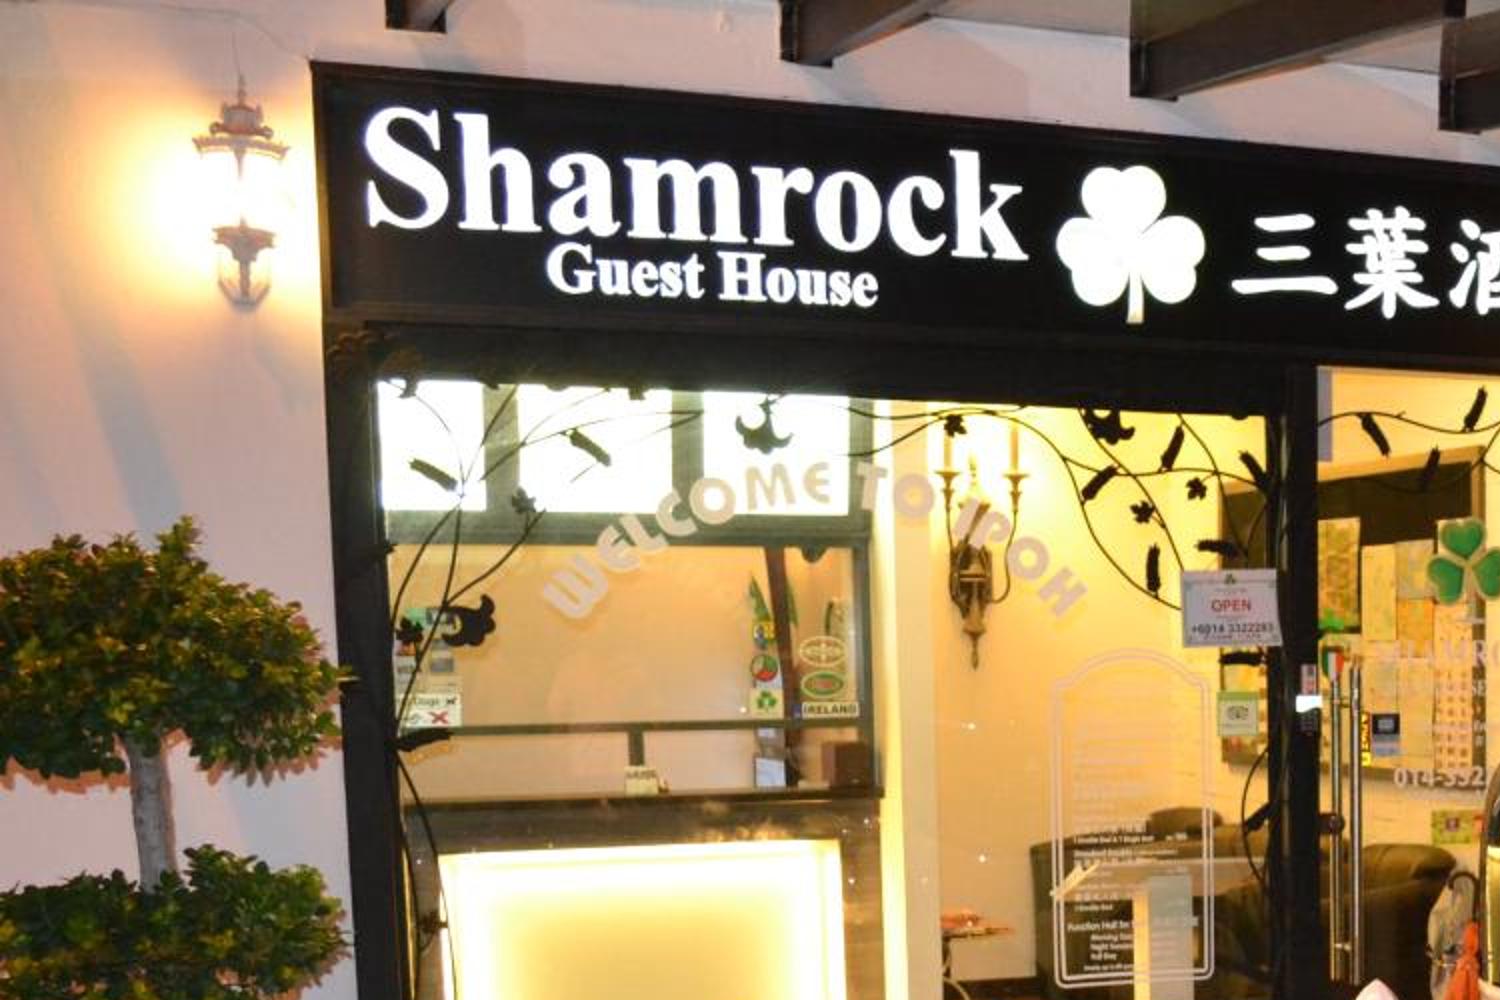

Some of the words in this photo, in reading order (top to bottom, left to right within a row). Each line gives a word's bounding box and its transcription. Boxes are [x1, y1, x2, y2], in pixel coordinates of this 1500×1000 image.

[363, 106, 1030, 262] Shamrock
[546, 242, 706, 300] Guest
[717, 250, 879, 307] House
[542, 461, 831, 620] WELCOME
[856, 462, 935, 518] TO
[953, 497, 1087, 619] IPOH
[1210, 598, 1252, 613] OPEN
[803, 703, 857, 715] IRELAND
